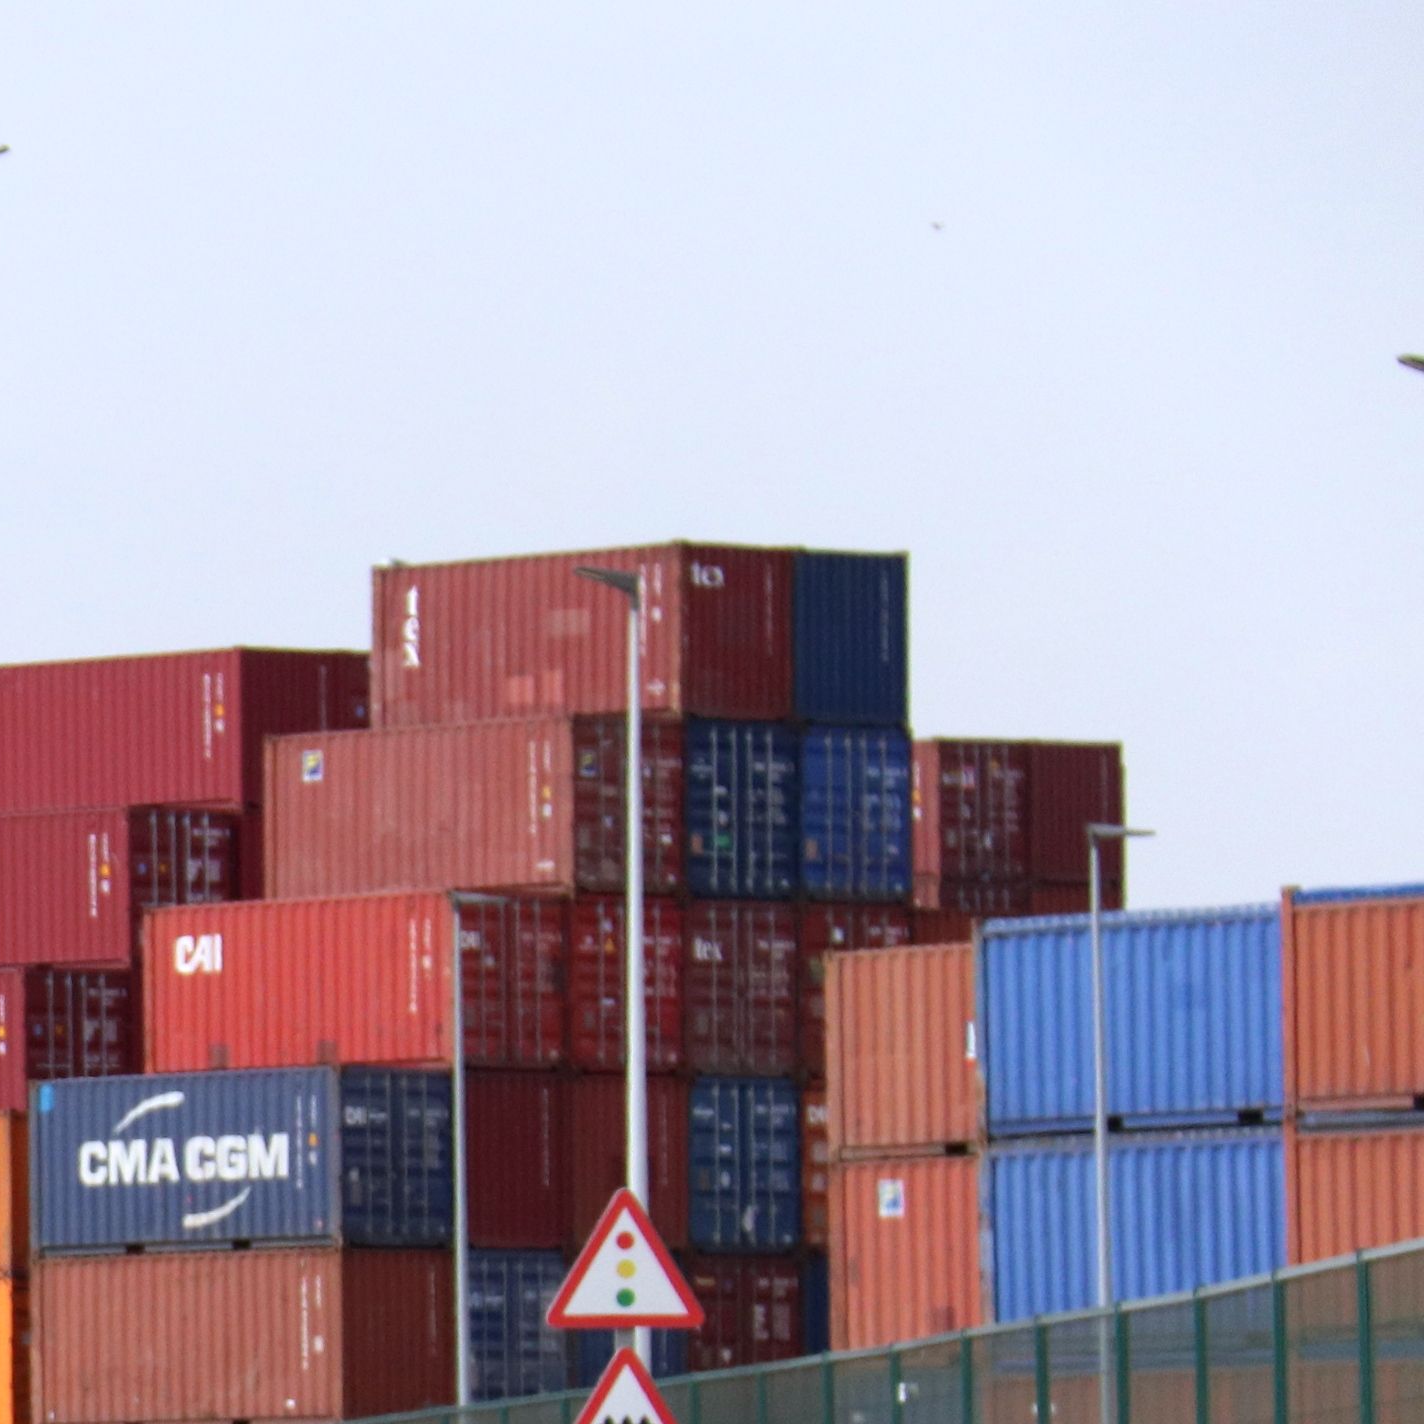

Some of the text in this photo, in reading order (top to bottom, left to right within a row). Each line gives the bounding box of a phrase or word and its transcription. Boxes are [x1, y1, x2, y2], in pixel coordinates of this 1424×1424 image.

[174, 932, 224, 973] CAI
[78, 1136, 181, 1188] CMA
[184, 1132, 290, 1181] CGM
